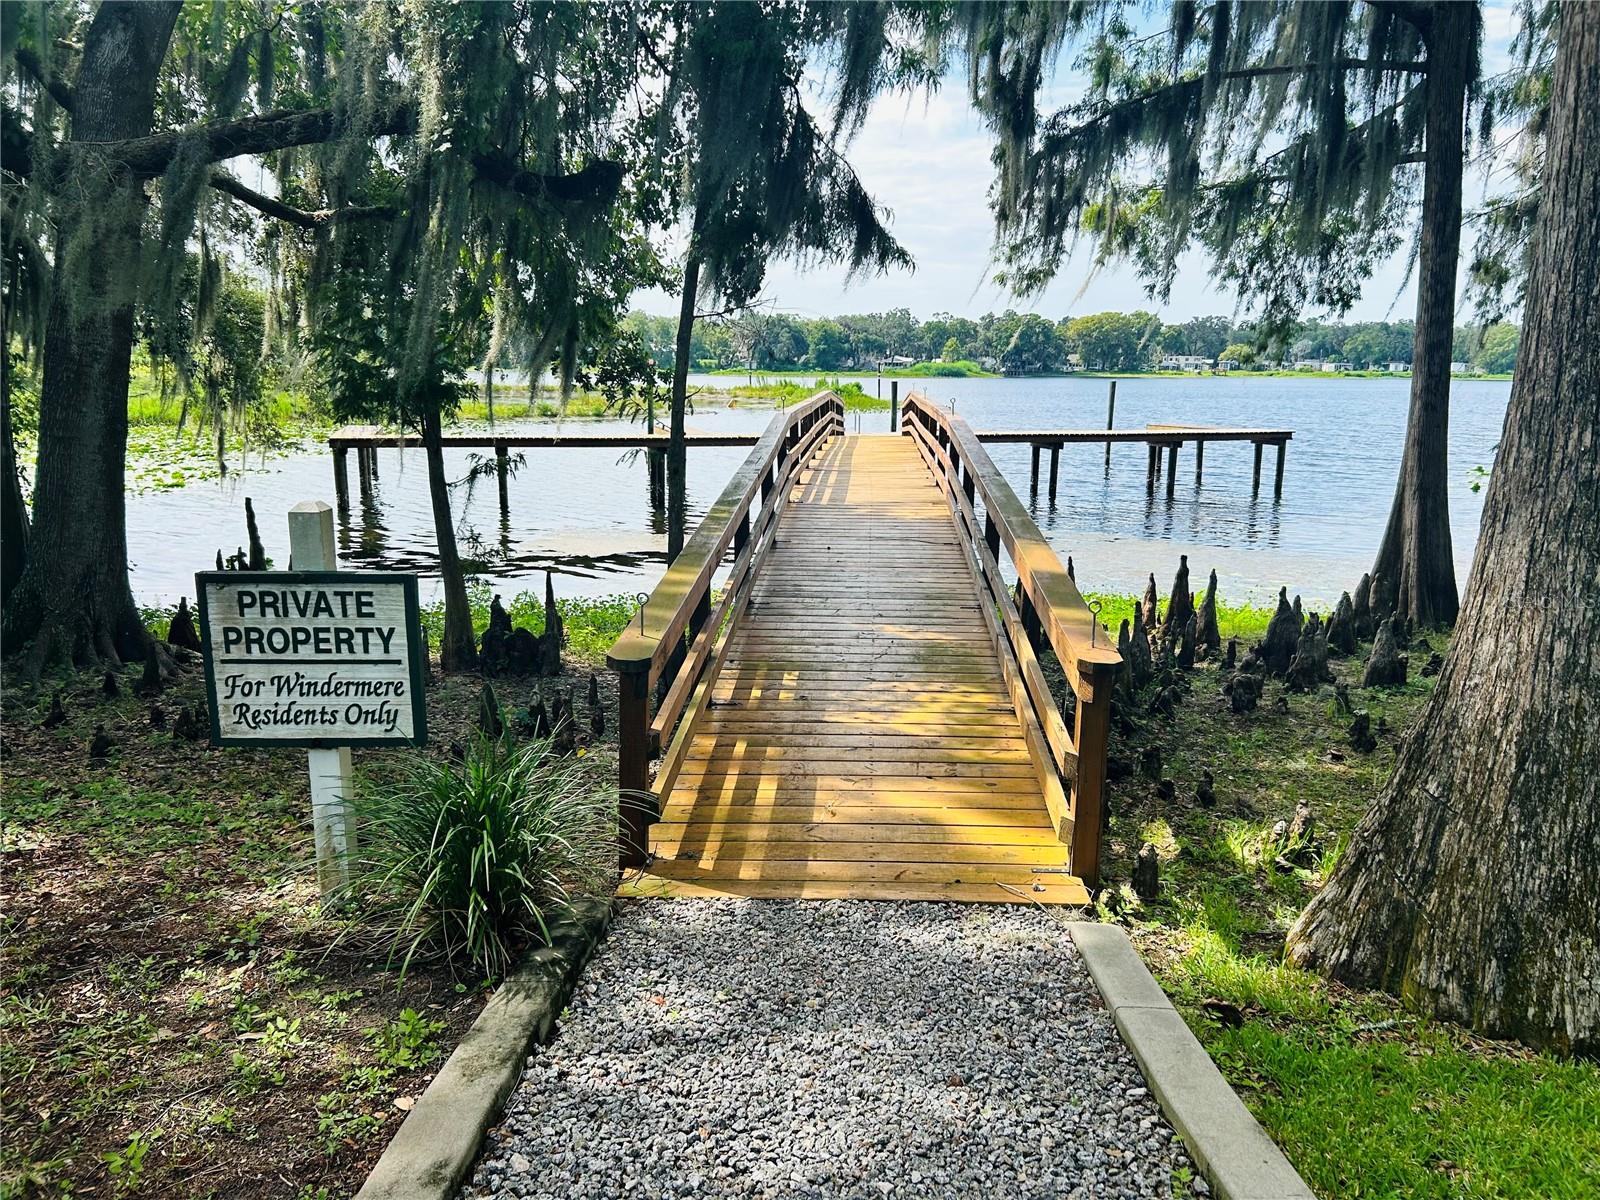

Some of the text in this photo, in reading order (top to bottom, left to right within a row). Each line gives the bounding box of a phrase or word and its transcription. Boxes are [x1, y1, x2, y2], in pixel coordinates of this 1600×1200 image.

[238, 591, 375, 618] PRIVATE
[222, 627, 396, 654] PROPERTY
[224, 671, 405, 700] For Windermere
[232, 700, 399, 732] Residents Only
